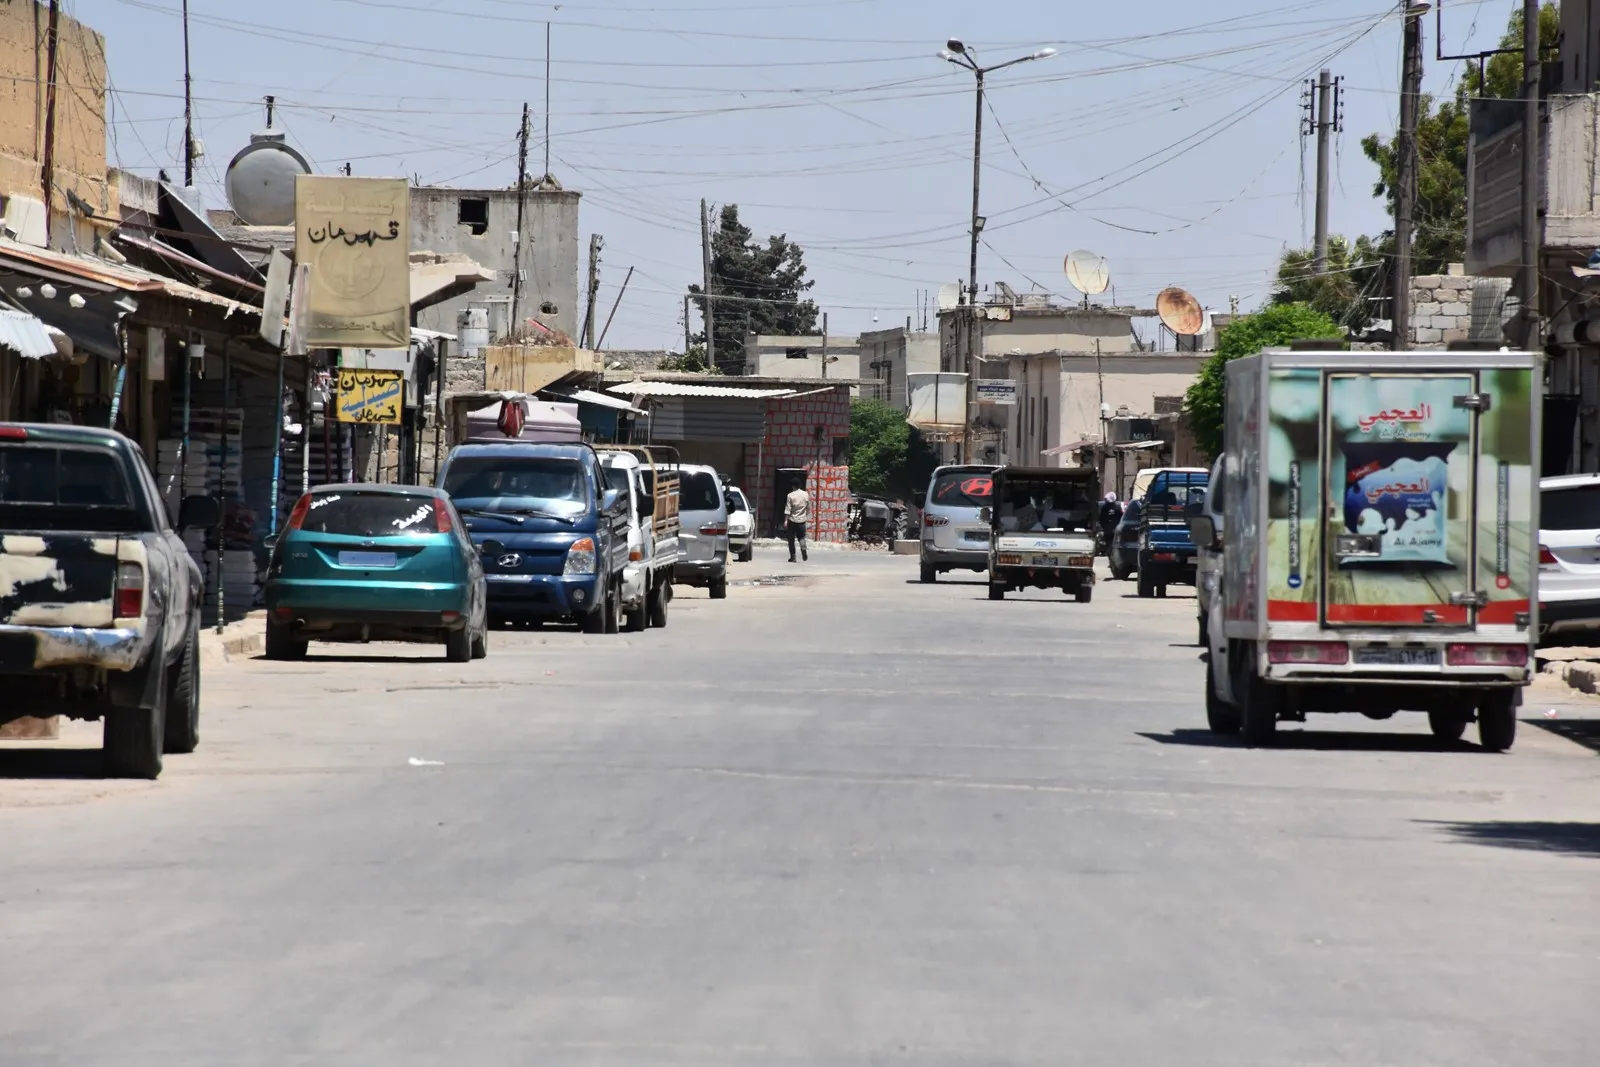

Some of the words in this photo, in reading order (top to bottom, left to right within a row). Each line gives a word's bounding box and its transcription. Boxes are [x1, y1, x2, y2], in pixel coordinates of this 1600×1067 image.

[308, 220, 399, 247] قهرمان
[341, 381, 400, 417] صيدلية
[1359, 403, 1431, 431] العجمي
[1366, 478, 1430, 504] العجمي
